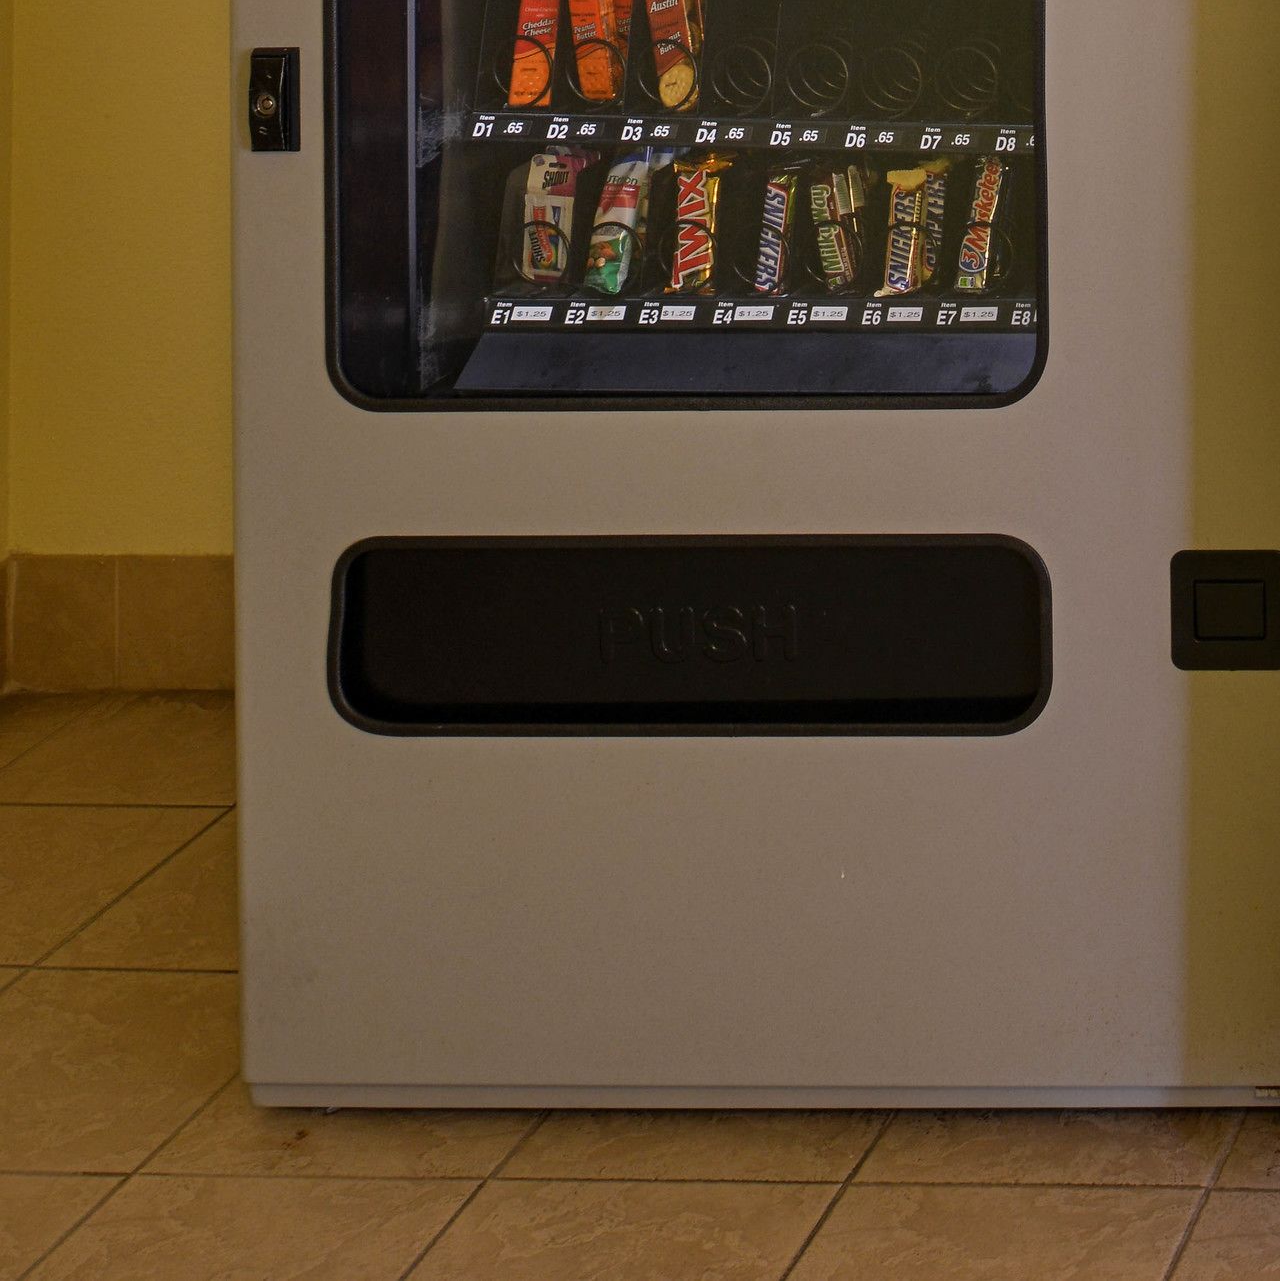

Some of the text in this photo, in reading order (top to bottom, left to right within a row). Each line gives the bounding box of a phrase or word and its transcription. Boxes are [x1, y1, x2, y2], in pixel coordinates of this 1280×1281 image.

[522, 19, 557, 31] Cheddar
[472, 123, 493, 137] D1
[504, 122, 523, 133] .65
[672, 169, 714, 289] TWIX
[491, 310, 510, 324] E1
